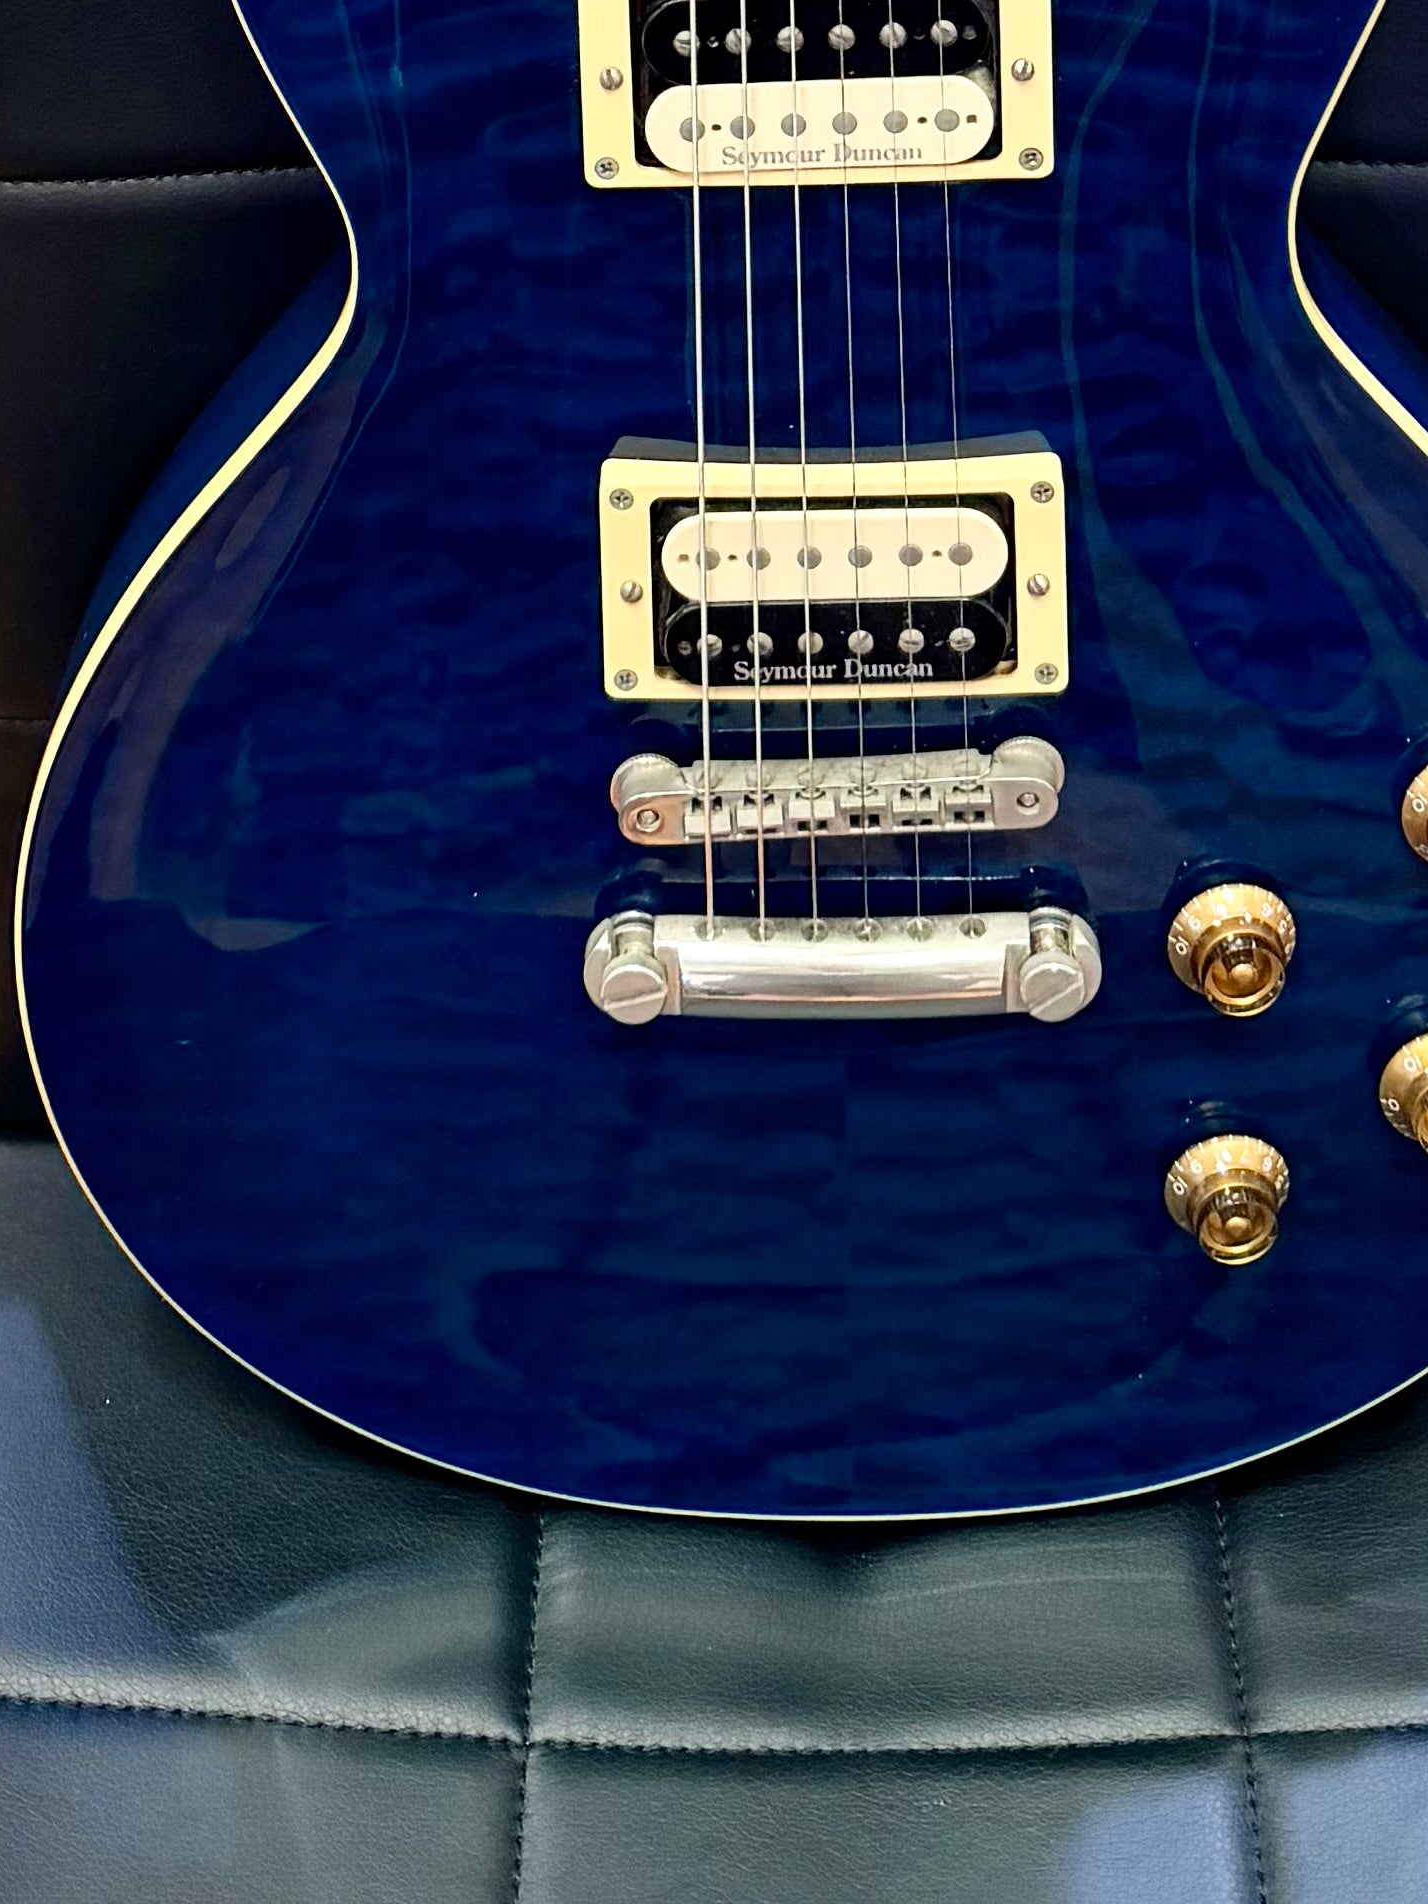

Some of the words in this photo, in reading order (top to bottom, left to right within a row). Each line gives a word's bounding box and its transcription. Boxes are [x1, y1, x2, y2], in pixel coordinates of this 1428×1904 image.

[721, 145, 827, 169] Seymour
[833, 142, 923, 163] Duncan
[733, 660, 838, 684] Seymour
[843, 657, 934, 679] Duncan
